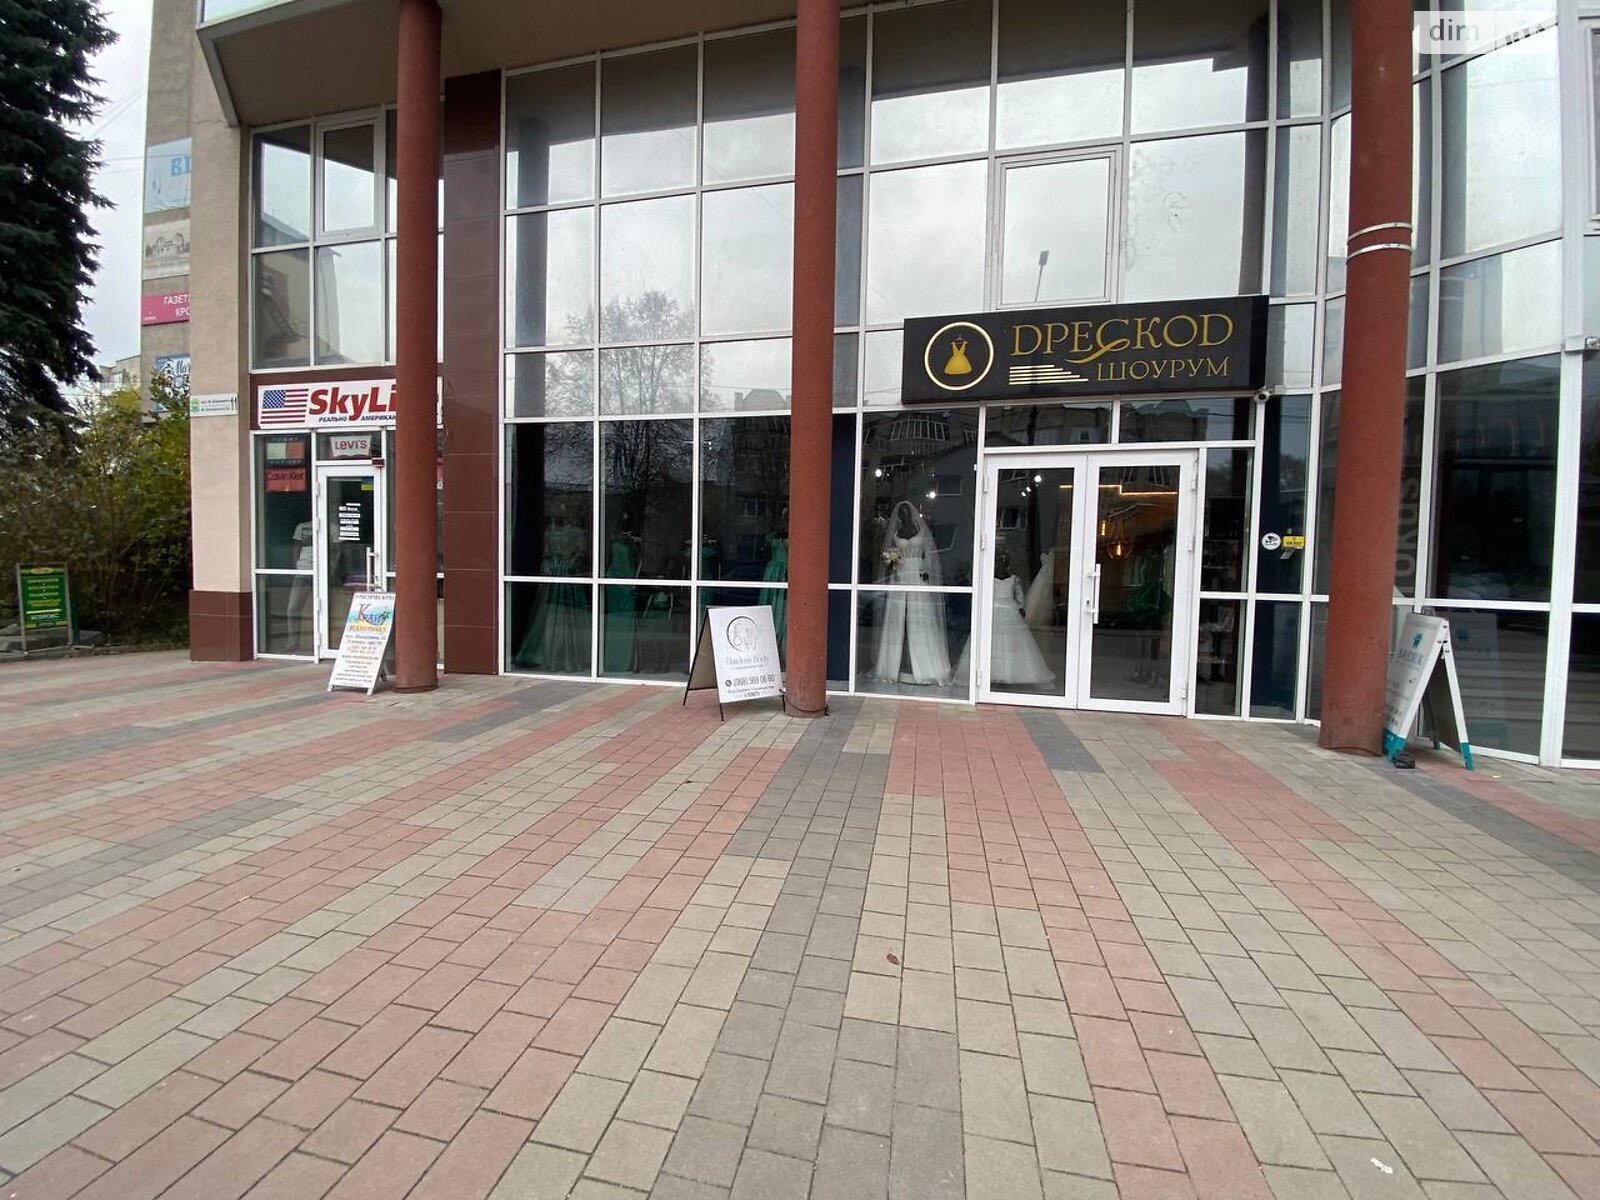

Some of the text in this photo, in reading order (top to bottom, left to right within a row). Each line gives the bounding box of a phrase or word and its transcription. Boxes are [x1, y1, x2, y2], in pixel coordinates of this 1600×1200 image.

[164, 294, 190, 306] ГАЗЕТ
[1097, 356, 1230, 381] ШОУРУМ
[309, 386, 396, 421] SkyLi
[318, 415, 348, 423] РЕАЛЬНО
